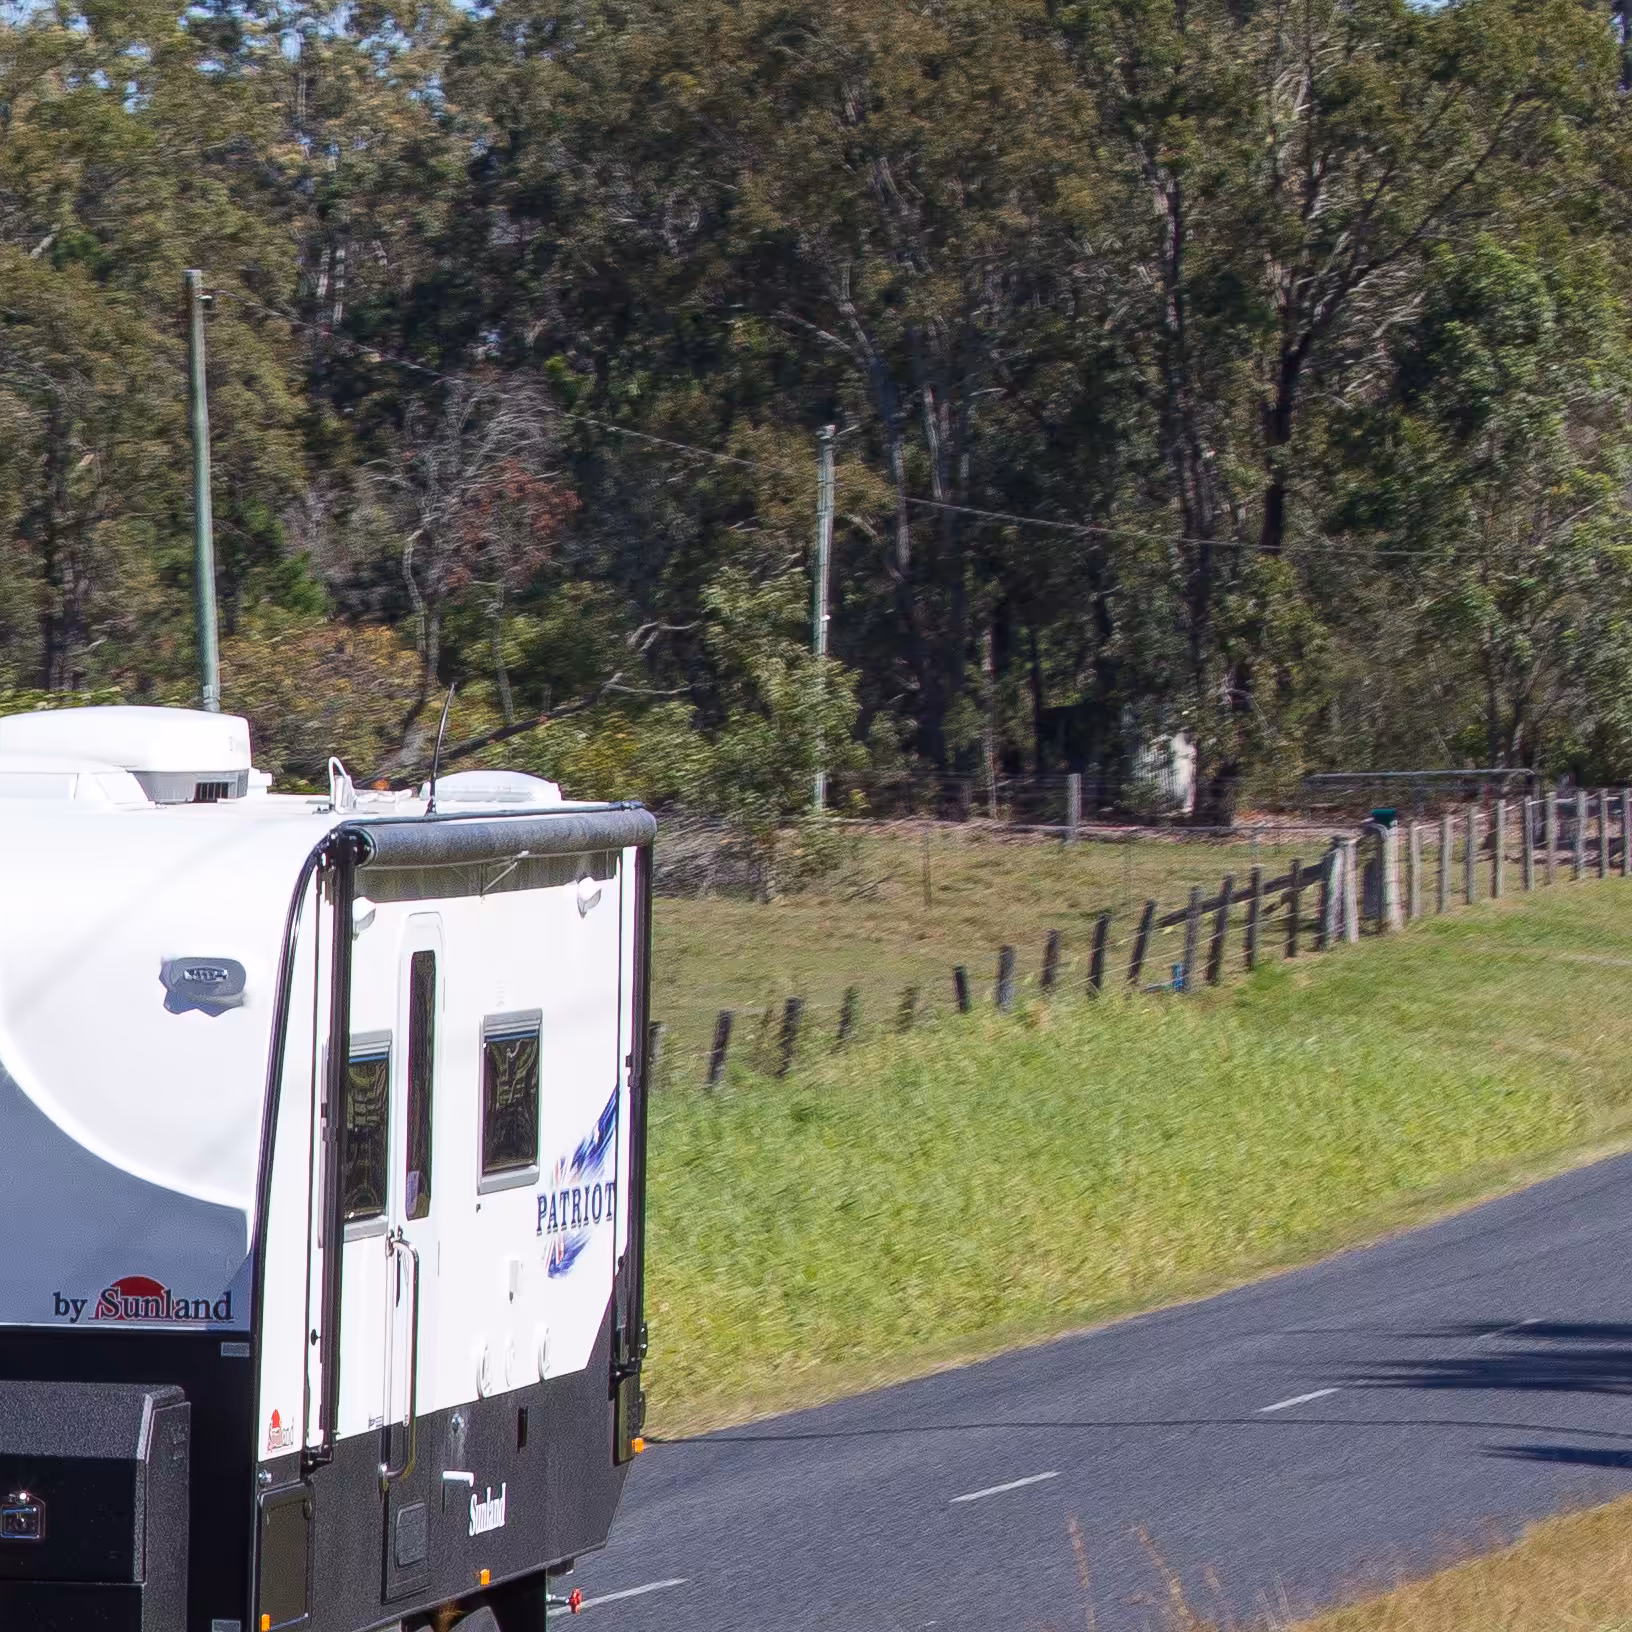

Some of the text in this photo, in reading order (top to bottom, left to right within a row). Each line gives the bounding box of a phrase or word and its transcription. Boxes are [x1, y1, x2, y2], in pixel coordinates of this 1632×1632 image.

[536, 1182, 615, 1236] PATRIOT
[53, 1287, 234, 1323] by Sunland
[469, 1481, 507, 1537] Sunland
